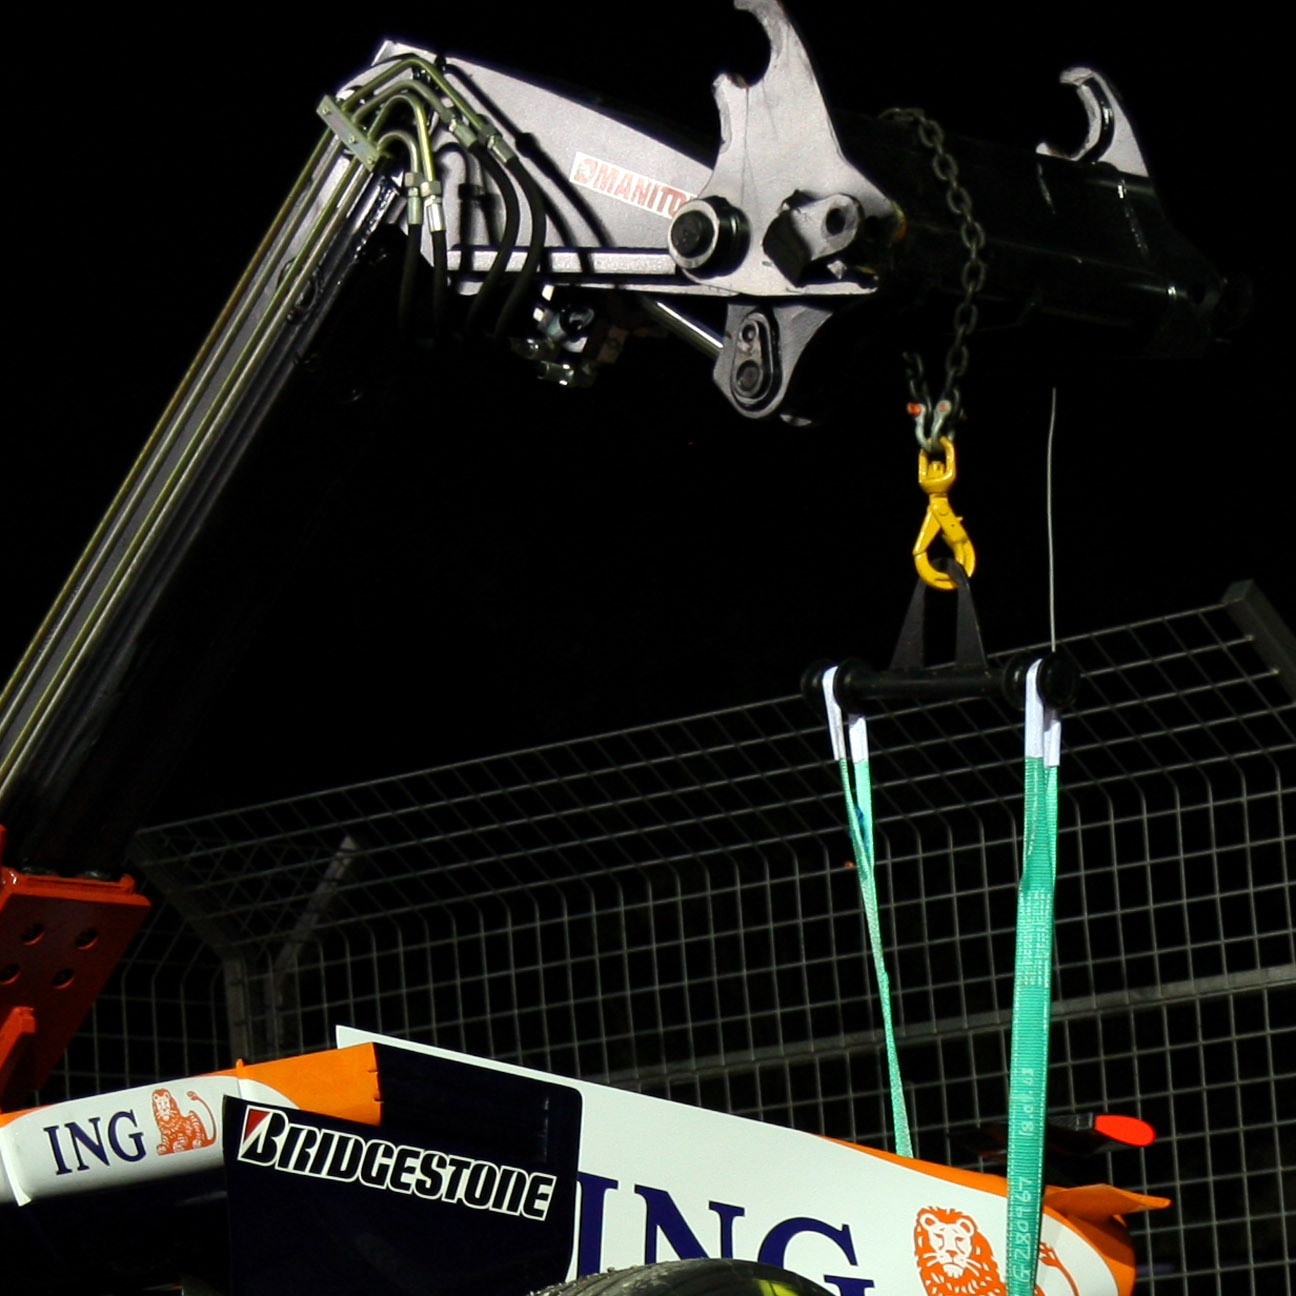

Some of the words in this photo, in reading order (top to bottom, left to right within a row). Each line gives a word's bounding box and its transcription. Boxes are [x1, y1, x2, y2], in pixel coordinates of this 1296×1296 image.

[593, 163, 697, 217] MANITO
[44, 1110, 147, 1175] ING
[237, 1106, 558, 1223] BRIDGESTONE
